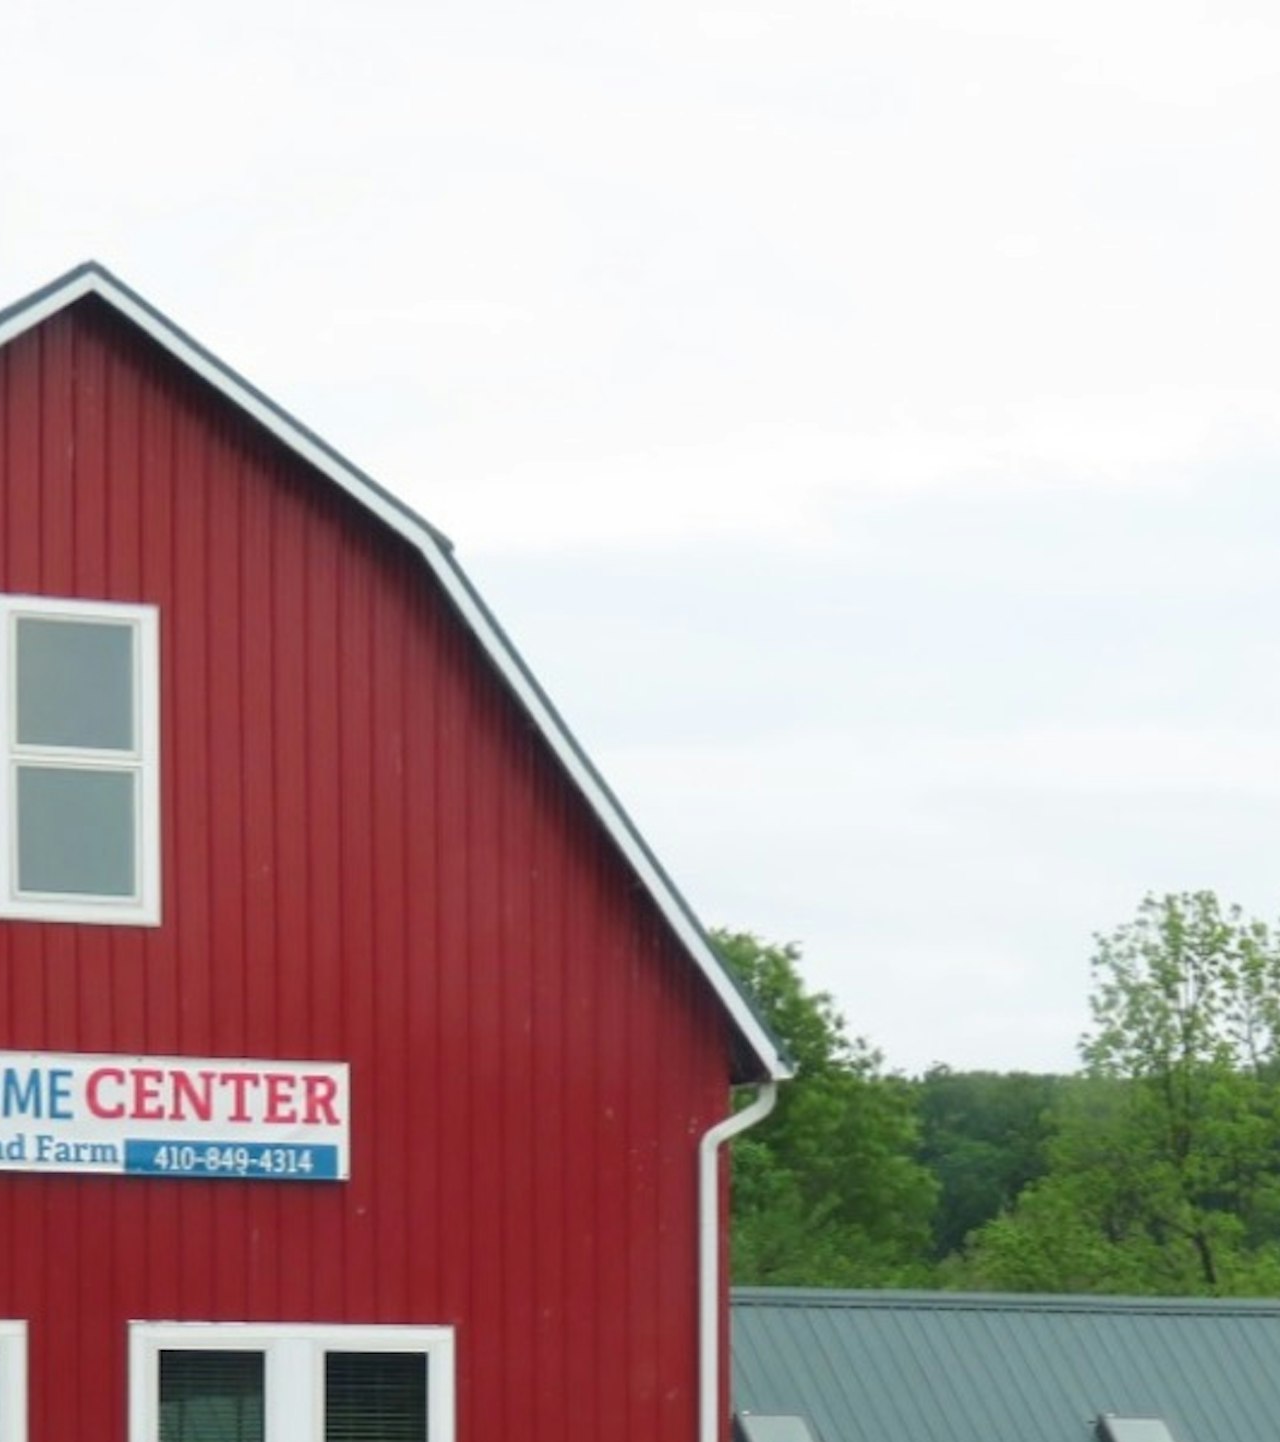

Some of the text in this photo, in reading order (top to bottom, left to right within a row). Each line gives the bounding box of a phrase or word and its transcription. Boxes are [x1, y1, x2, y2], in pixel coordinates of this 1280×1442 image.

[85, 1067, 341, 1126] CENTER
[34, 1135, 118, 1164] Farm
[153, 1145, 314, 1174] 410-849-4314
